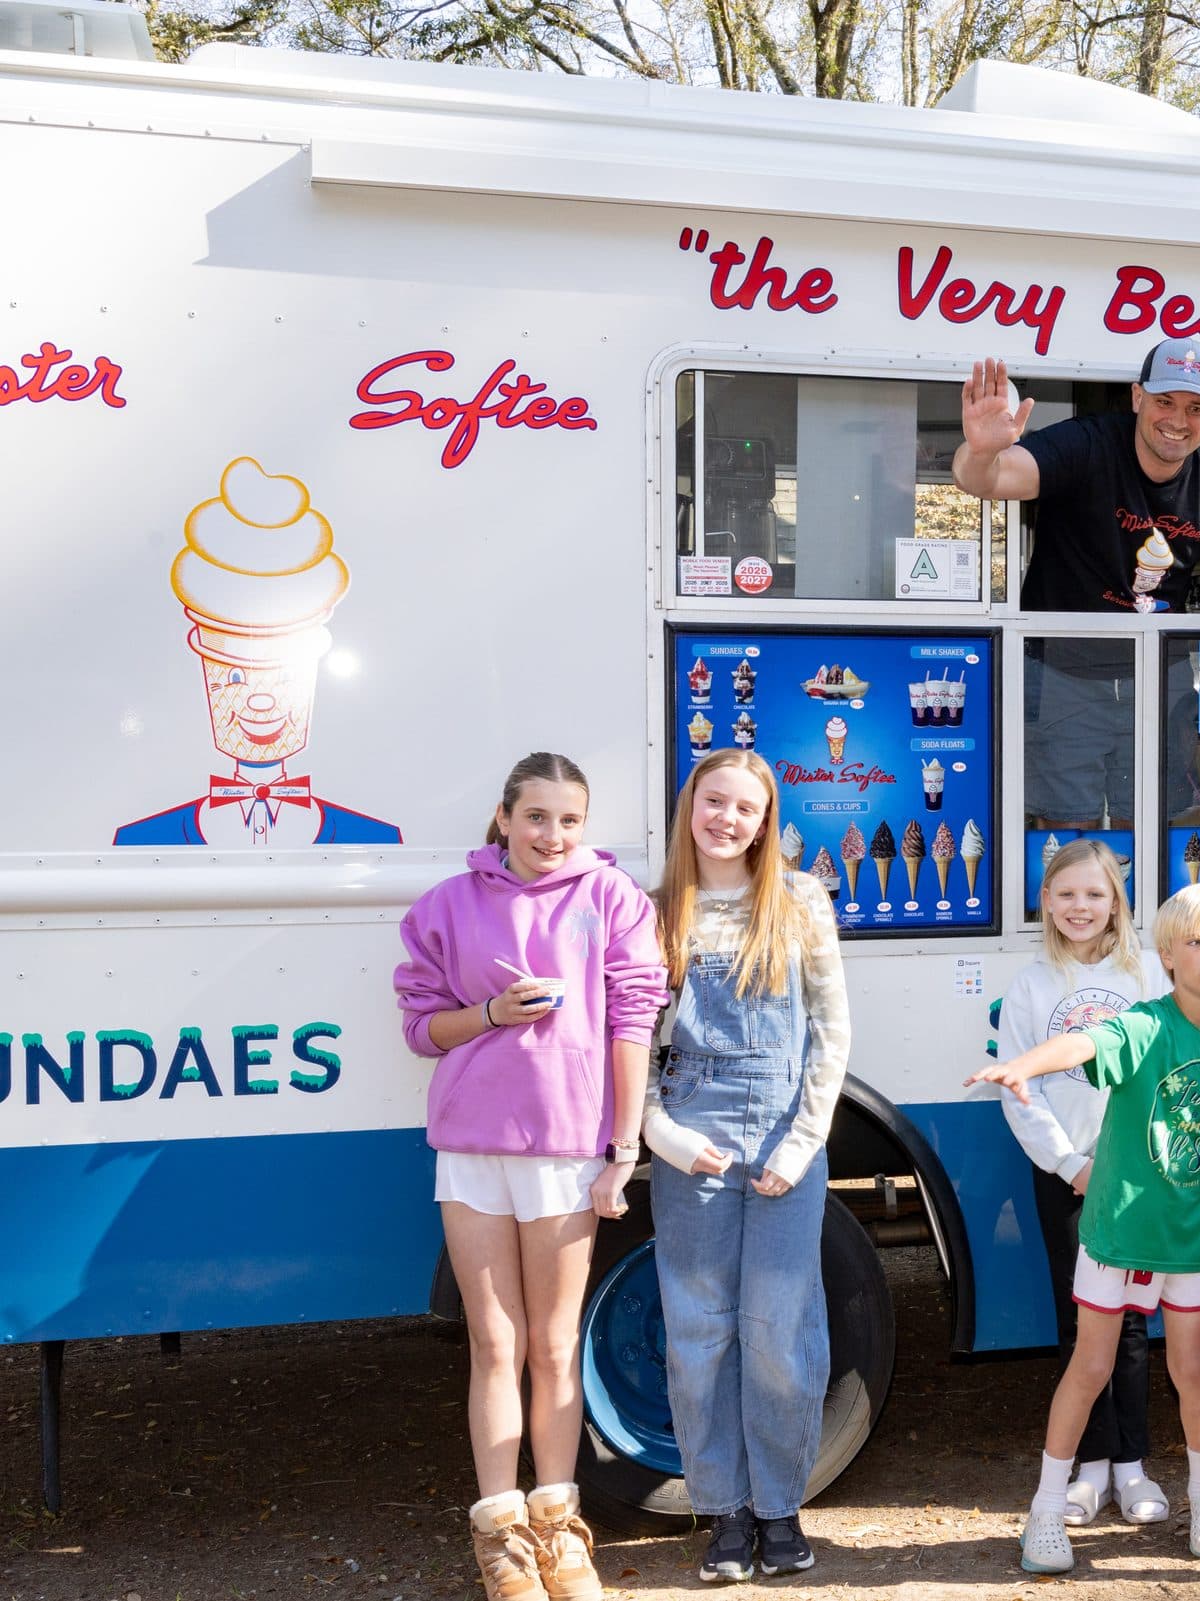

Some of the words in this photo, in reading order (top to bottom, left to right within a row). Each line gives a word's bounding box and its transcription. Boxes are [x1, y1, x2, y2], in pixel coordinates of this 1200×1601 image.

[898, 245, 1067, 356] Very
[349, 350, 598, 469] Softee
[910, 548, 939, 579] A
[741, 566, 768, 575] 2026
[740, 576, 768, 585] 2027
[710, 647, 743, 655] SUNDAES
[939, 648, 965, 656] SHAKES
[921, 740, 940, 749] SODA
[941, 740, 965, 748] FLOATS
[775, 759, 835, 786] Mister
[837, 762, 897, 792] Softee
[811, 803, 835, 811] CONES
[836, 803, 842, 811] &
[843, 802, 862, 810] CUPS
